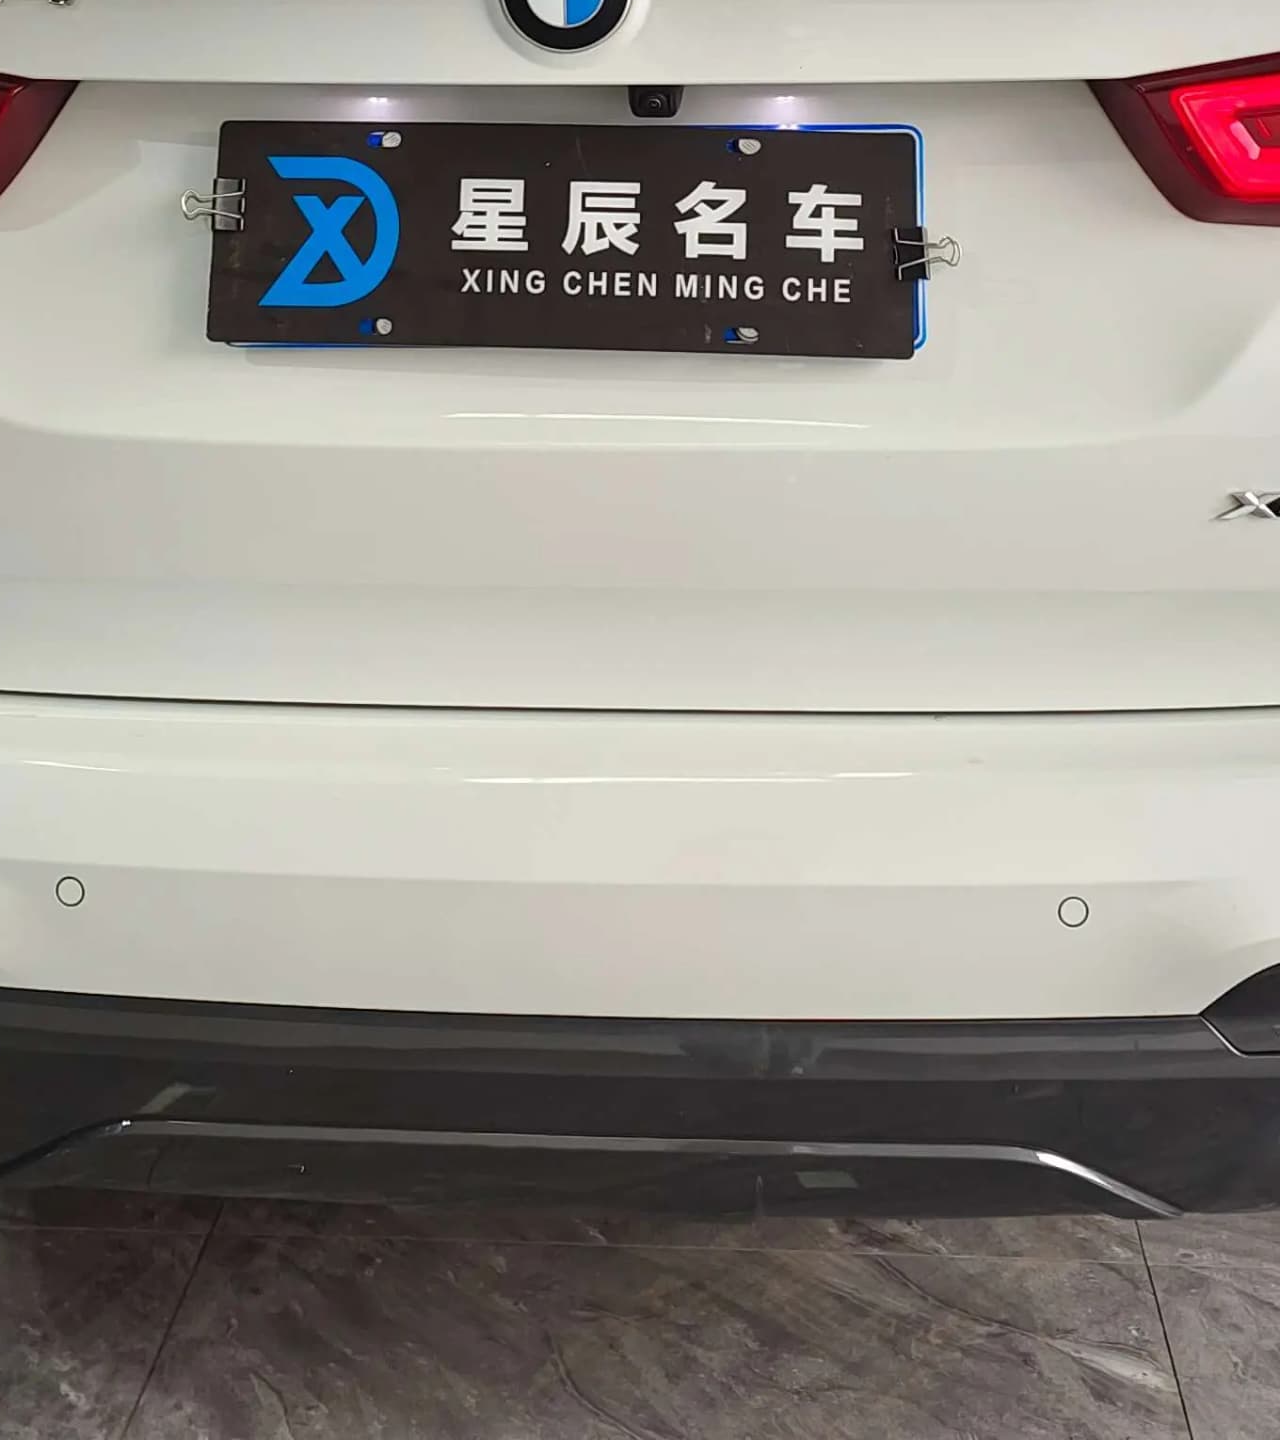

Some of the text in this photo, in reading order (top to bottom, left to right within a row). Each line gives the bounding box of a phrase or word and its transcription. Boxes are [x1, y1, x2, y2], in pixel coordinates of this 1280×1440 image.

[451, 178, 864, 263] 星辰名车
[461, 268, 852, 303] XING CHEN MING CHE
